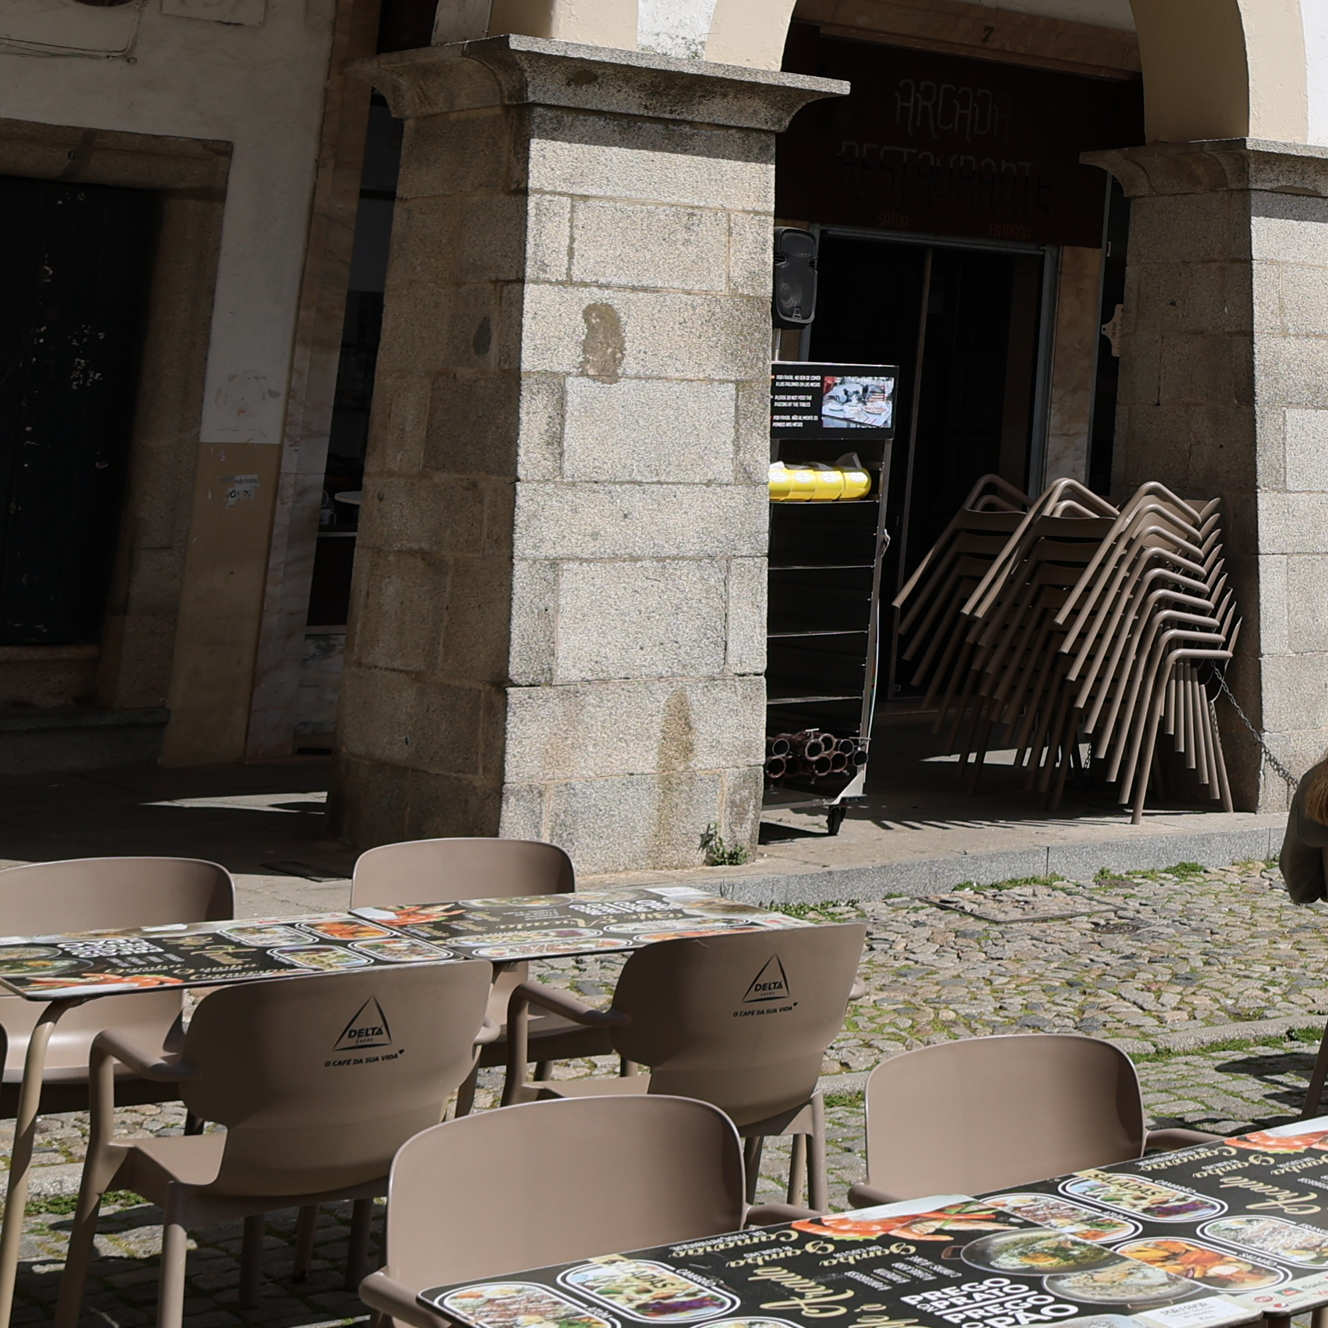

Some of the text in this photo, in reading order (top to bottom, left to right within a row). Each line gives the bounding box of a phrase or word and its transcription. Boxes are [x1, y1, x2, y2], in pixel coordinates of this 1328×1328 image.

[981, 26, 995, 43] 7
[895, 78, 1010, 144] ARCADA
[754, 981, 783, 992] DELTA
[347, 1026, 383, 1039] DELTA
[749, 1266, 855, 1317] Arcada
[899, 1278, 1011, 1304] PREGO
[926, 1285, 1029, 1310] PRATO
[942, 1293, 1052, 1324] PREGO
[983, 1303, 1078, 1328] PÃO
